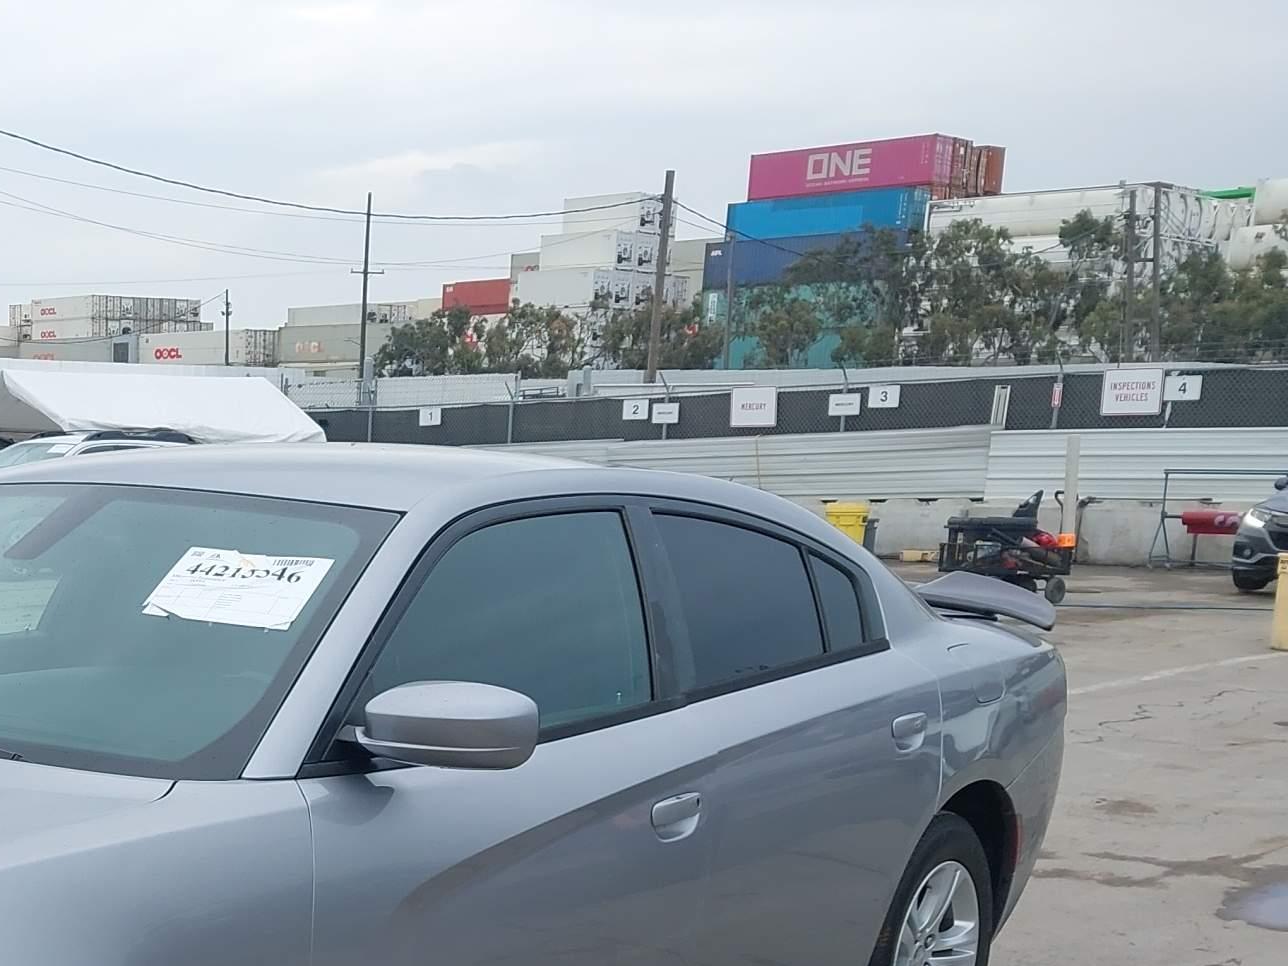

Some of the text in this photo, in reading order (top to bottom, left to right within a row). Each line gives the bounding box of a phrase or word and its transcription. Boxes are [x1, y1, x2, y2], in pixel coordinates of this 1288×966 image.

[806, 148, 873, 180] ONE
[154, 347, 182, 360] OOCL
[1110, 381, 1156, 391] INSPECTIONS
[1178, 382, 1187, 394] 4
[880, 391, 888, 402] 3
[1115, 393, 1149, 402] VEHICLES
[632, 405, 640, 415] 2
[428, 412, 433, 421] 1
